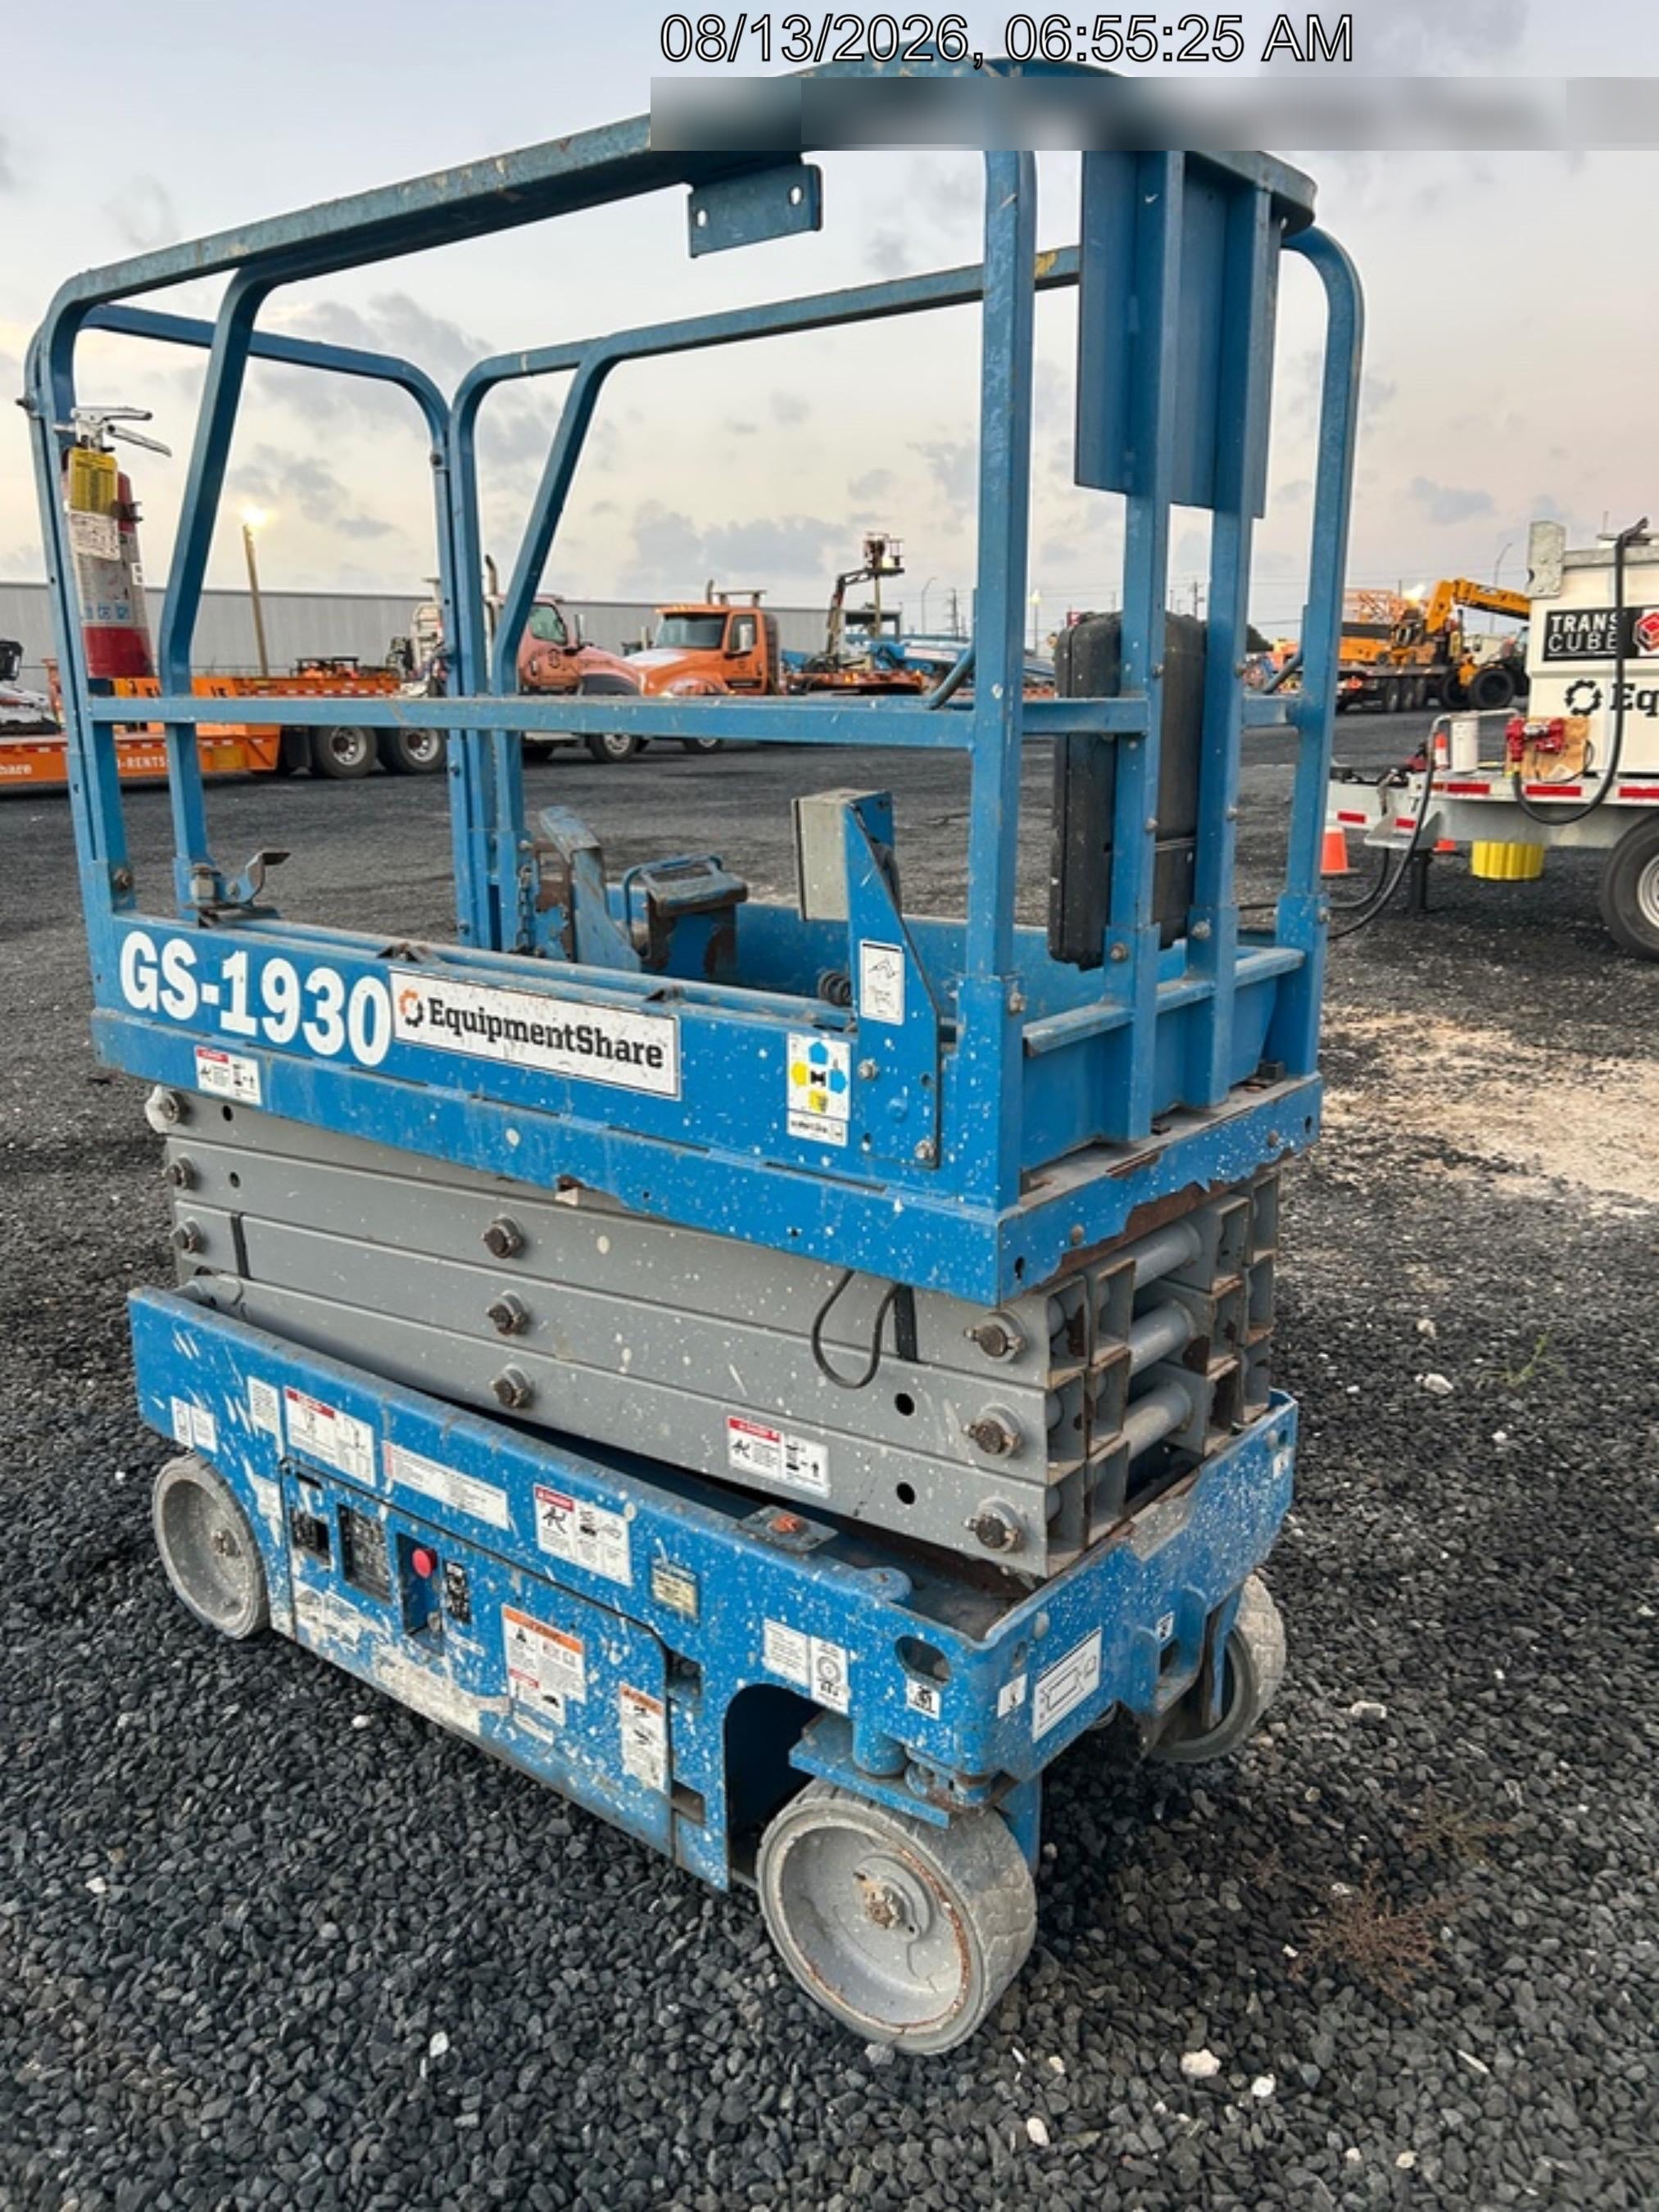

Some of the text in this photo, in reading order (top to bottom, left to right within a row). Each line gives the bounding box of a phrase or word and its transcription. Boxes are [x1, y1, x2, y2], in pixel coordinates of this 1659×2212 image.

[1548, 632, 1618, 652] CUBE
[1550, 613, 1618, 633] TRANS
[119, 930, 392, 1067] GS-1930
[428, 996, 664, 1068] EquipmentShare
